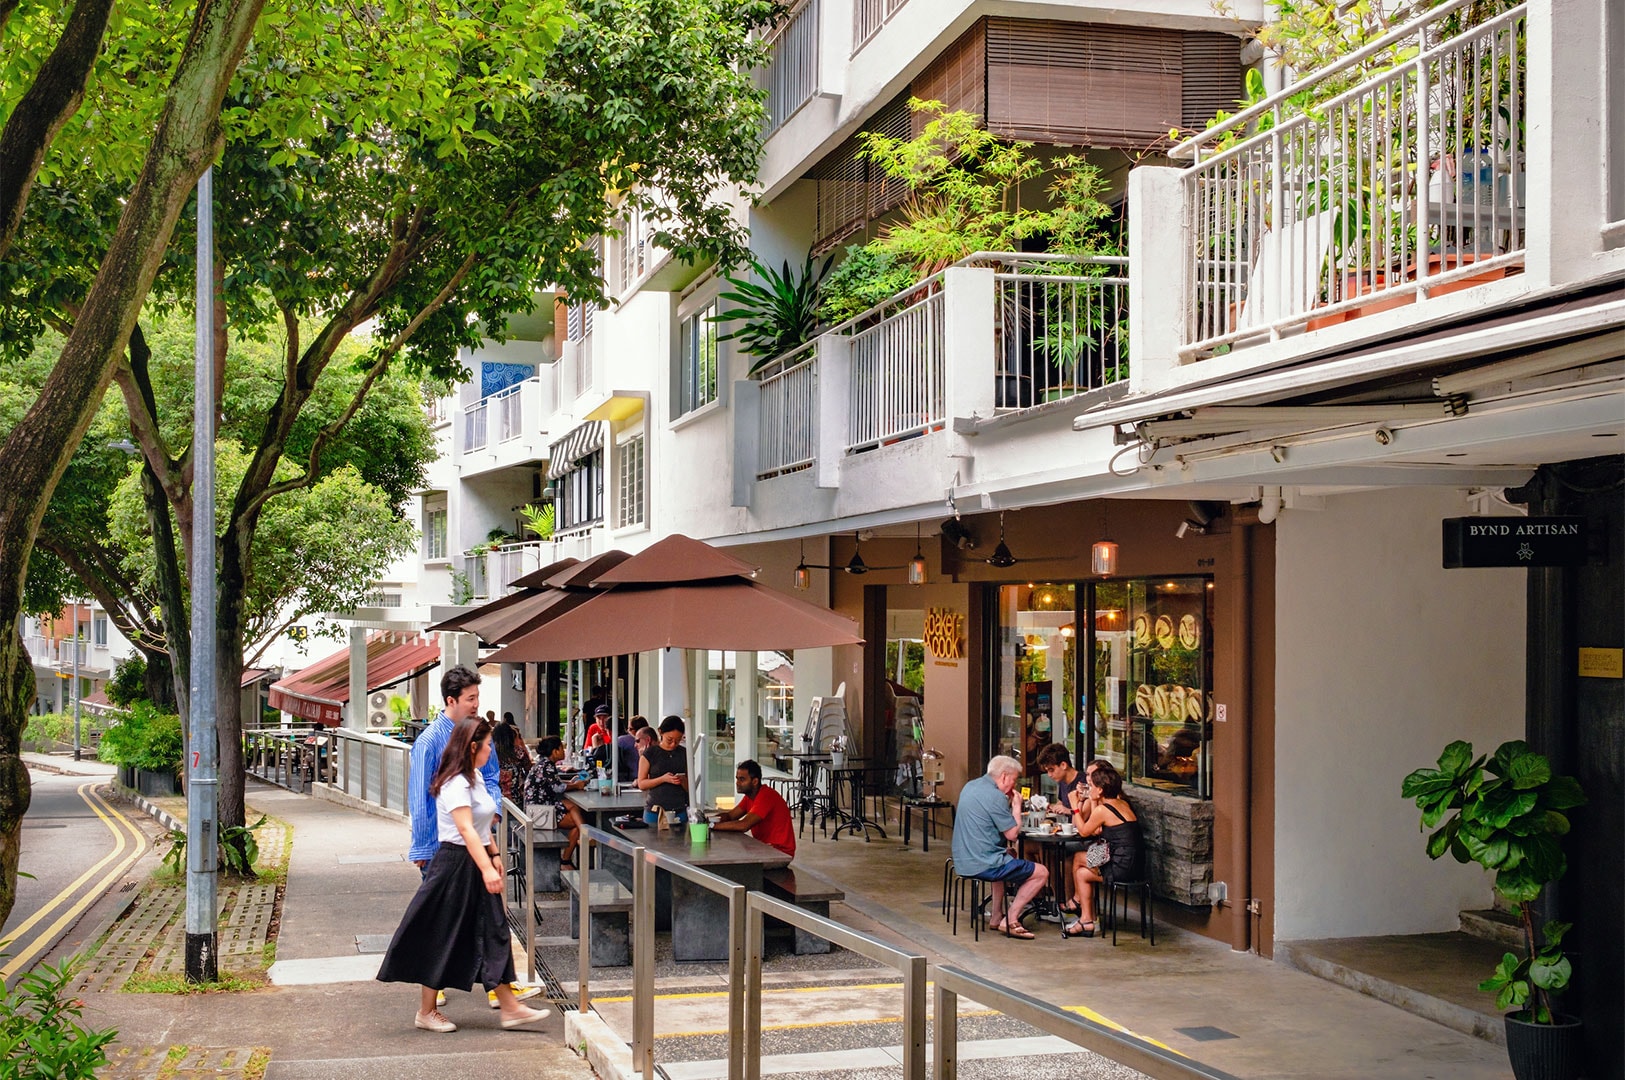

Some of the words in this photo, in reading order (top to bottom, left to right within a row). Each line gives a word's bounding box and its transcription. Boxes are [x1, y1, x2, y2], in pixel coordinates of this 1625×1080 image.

[1470, 525, 1510, 536] BYND
[1516, 524, 1579, 535] ARTISAN
[928, 608, 958, 636] baker
[923, 619, 934, 656] &
[932, 636, 959, 658] cook
[192, 751, 200, 768] 7
